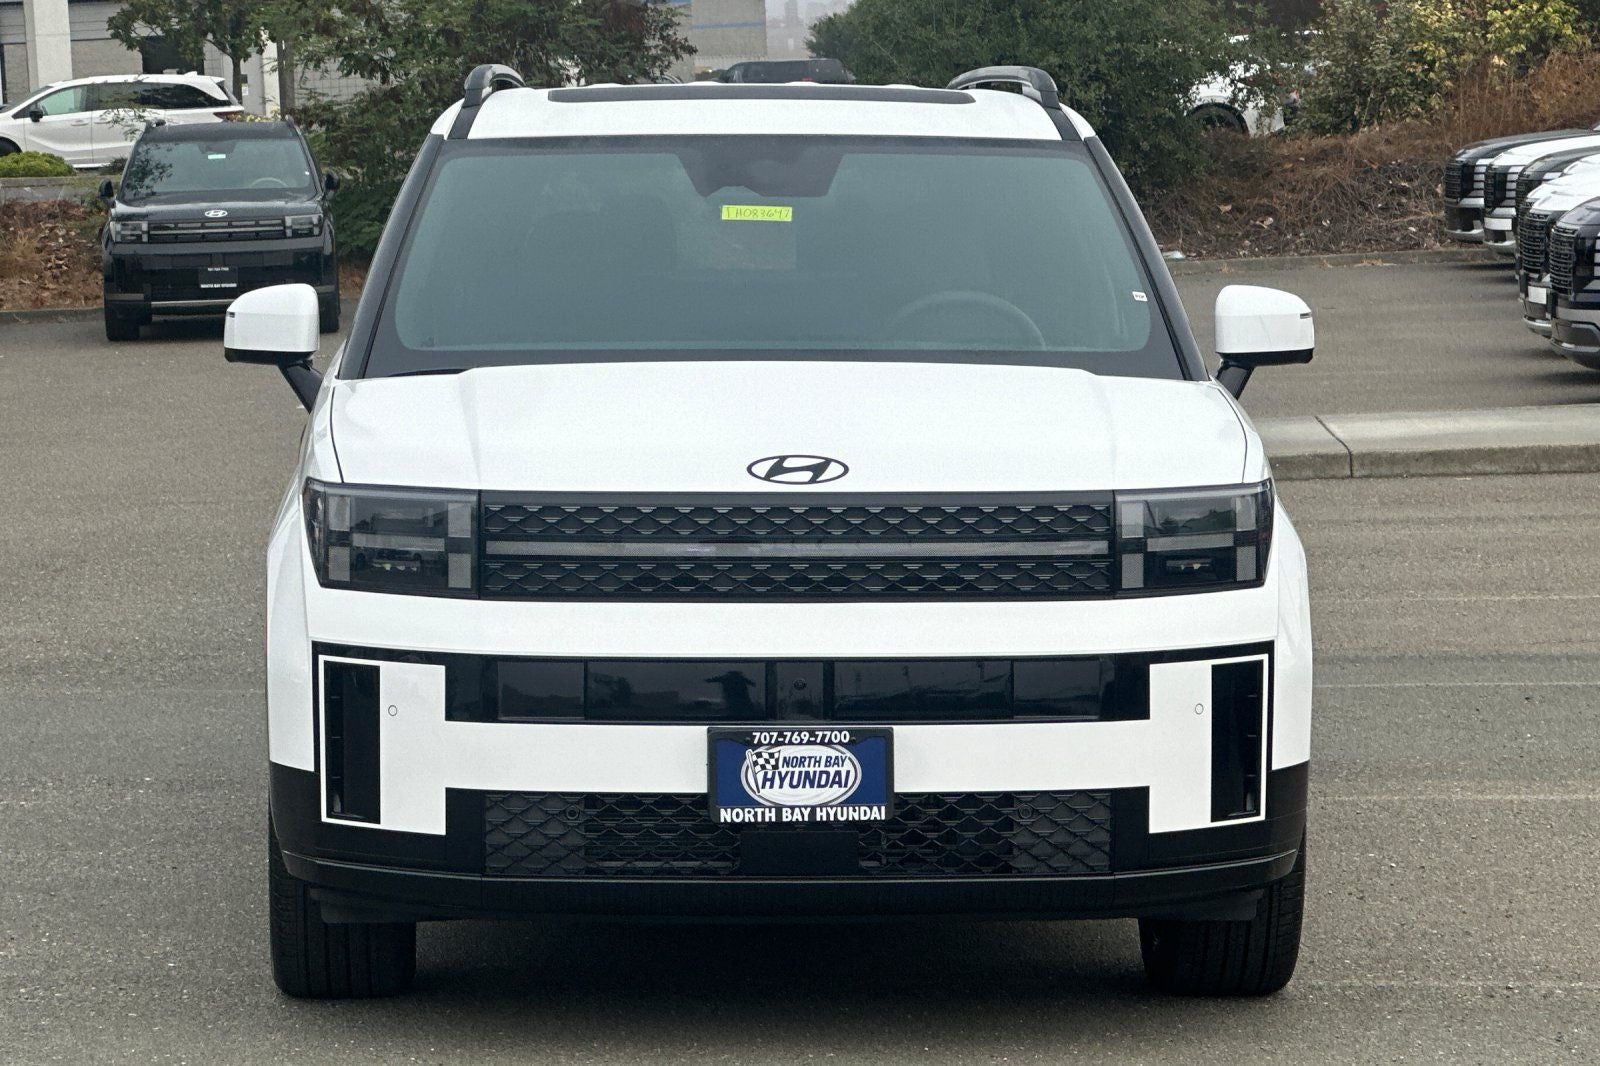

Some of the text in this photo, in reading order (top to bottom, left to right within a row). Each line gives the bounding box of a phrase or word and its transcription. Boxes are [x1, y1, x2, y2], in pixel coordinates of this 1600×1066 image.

[752, 731, 850, 744] 707-769-7700
[781, 755, 848, 768] NORTH BAY
[761, 770, 851, 789] HYUNDAI
[720, 806, 886, 822] NORTH BAY HYUNDAI
